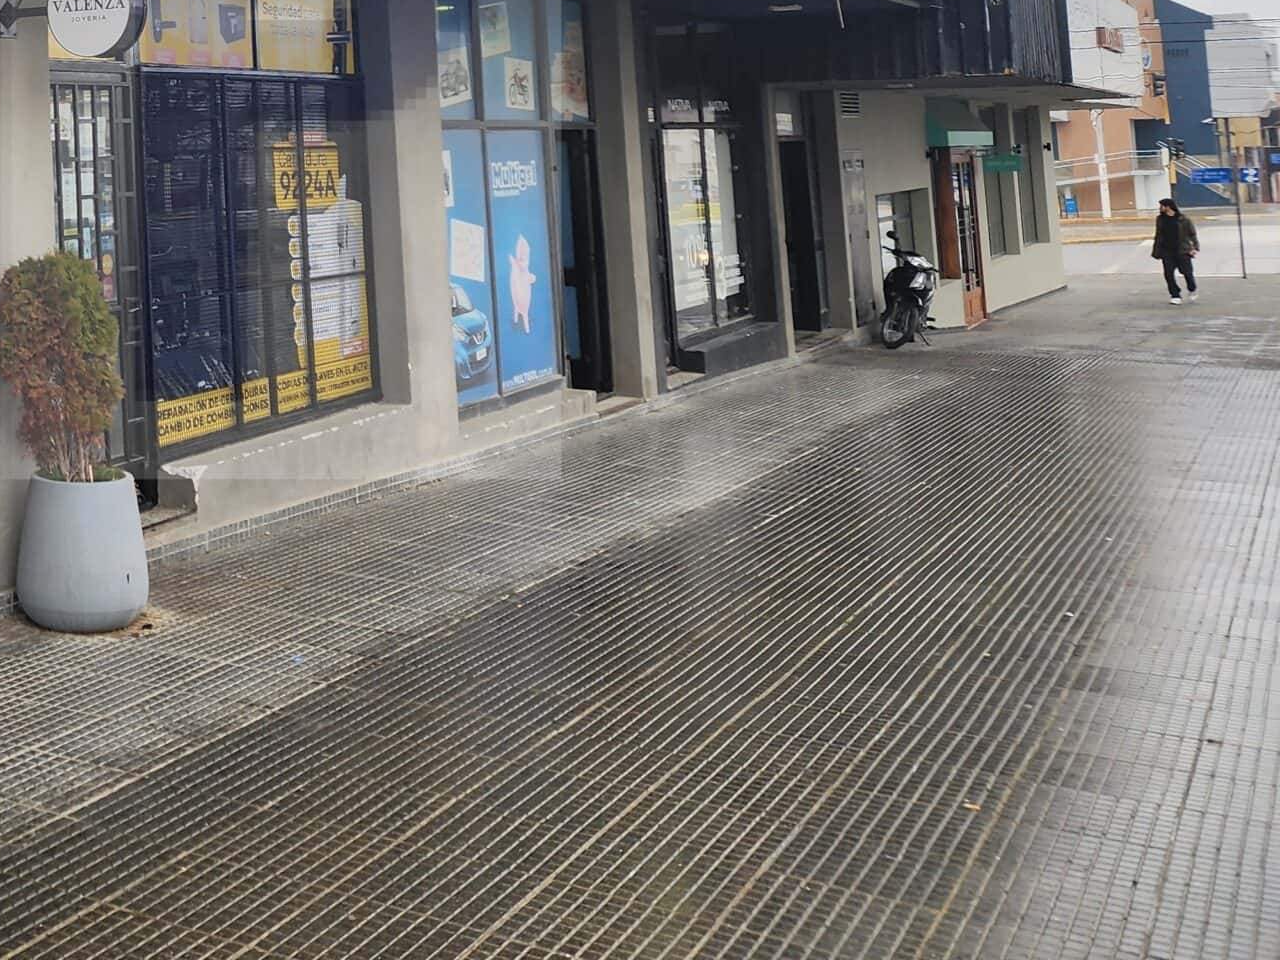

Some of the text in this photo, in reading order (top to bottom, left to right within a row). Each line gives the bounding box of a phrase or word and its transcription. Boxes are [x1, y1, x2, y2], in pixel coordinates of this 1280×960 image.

[71, 15, 107, 23] JOYERIA
[262, 1, 303, 19] Seguridad
[158, 420, 192, 437] CAMBIO
[193, 415, 205, 428] DE
